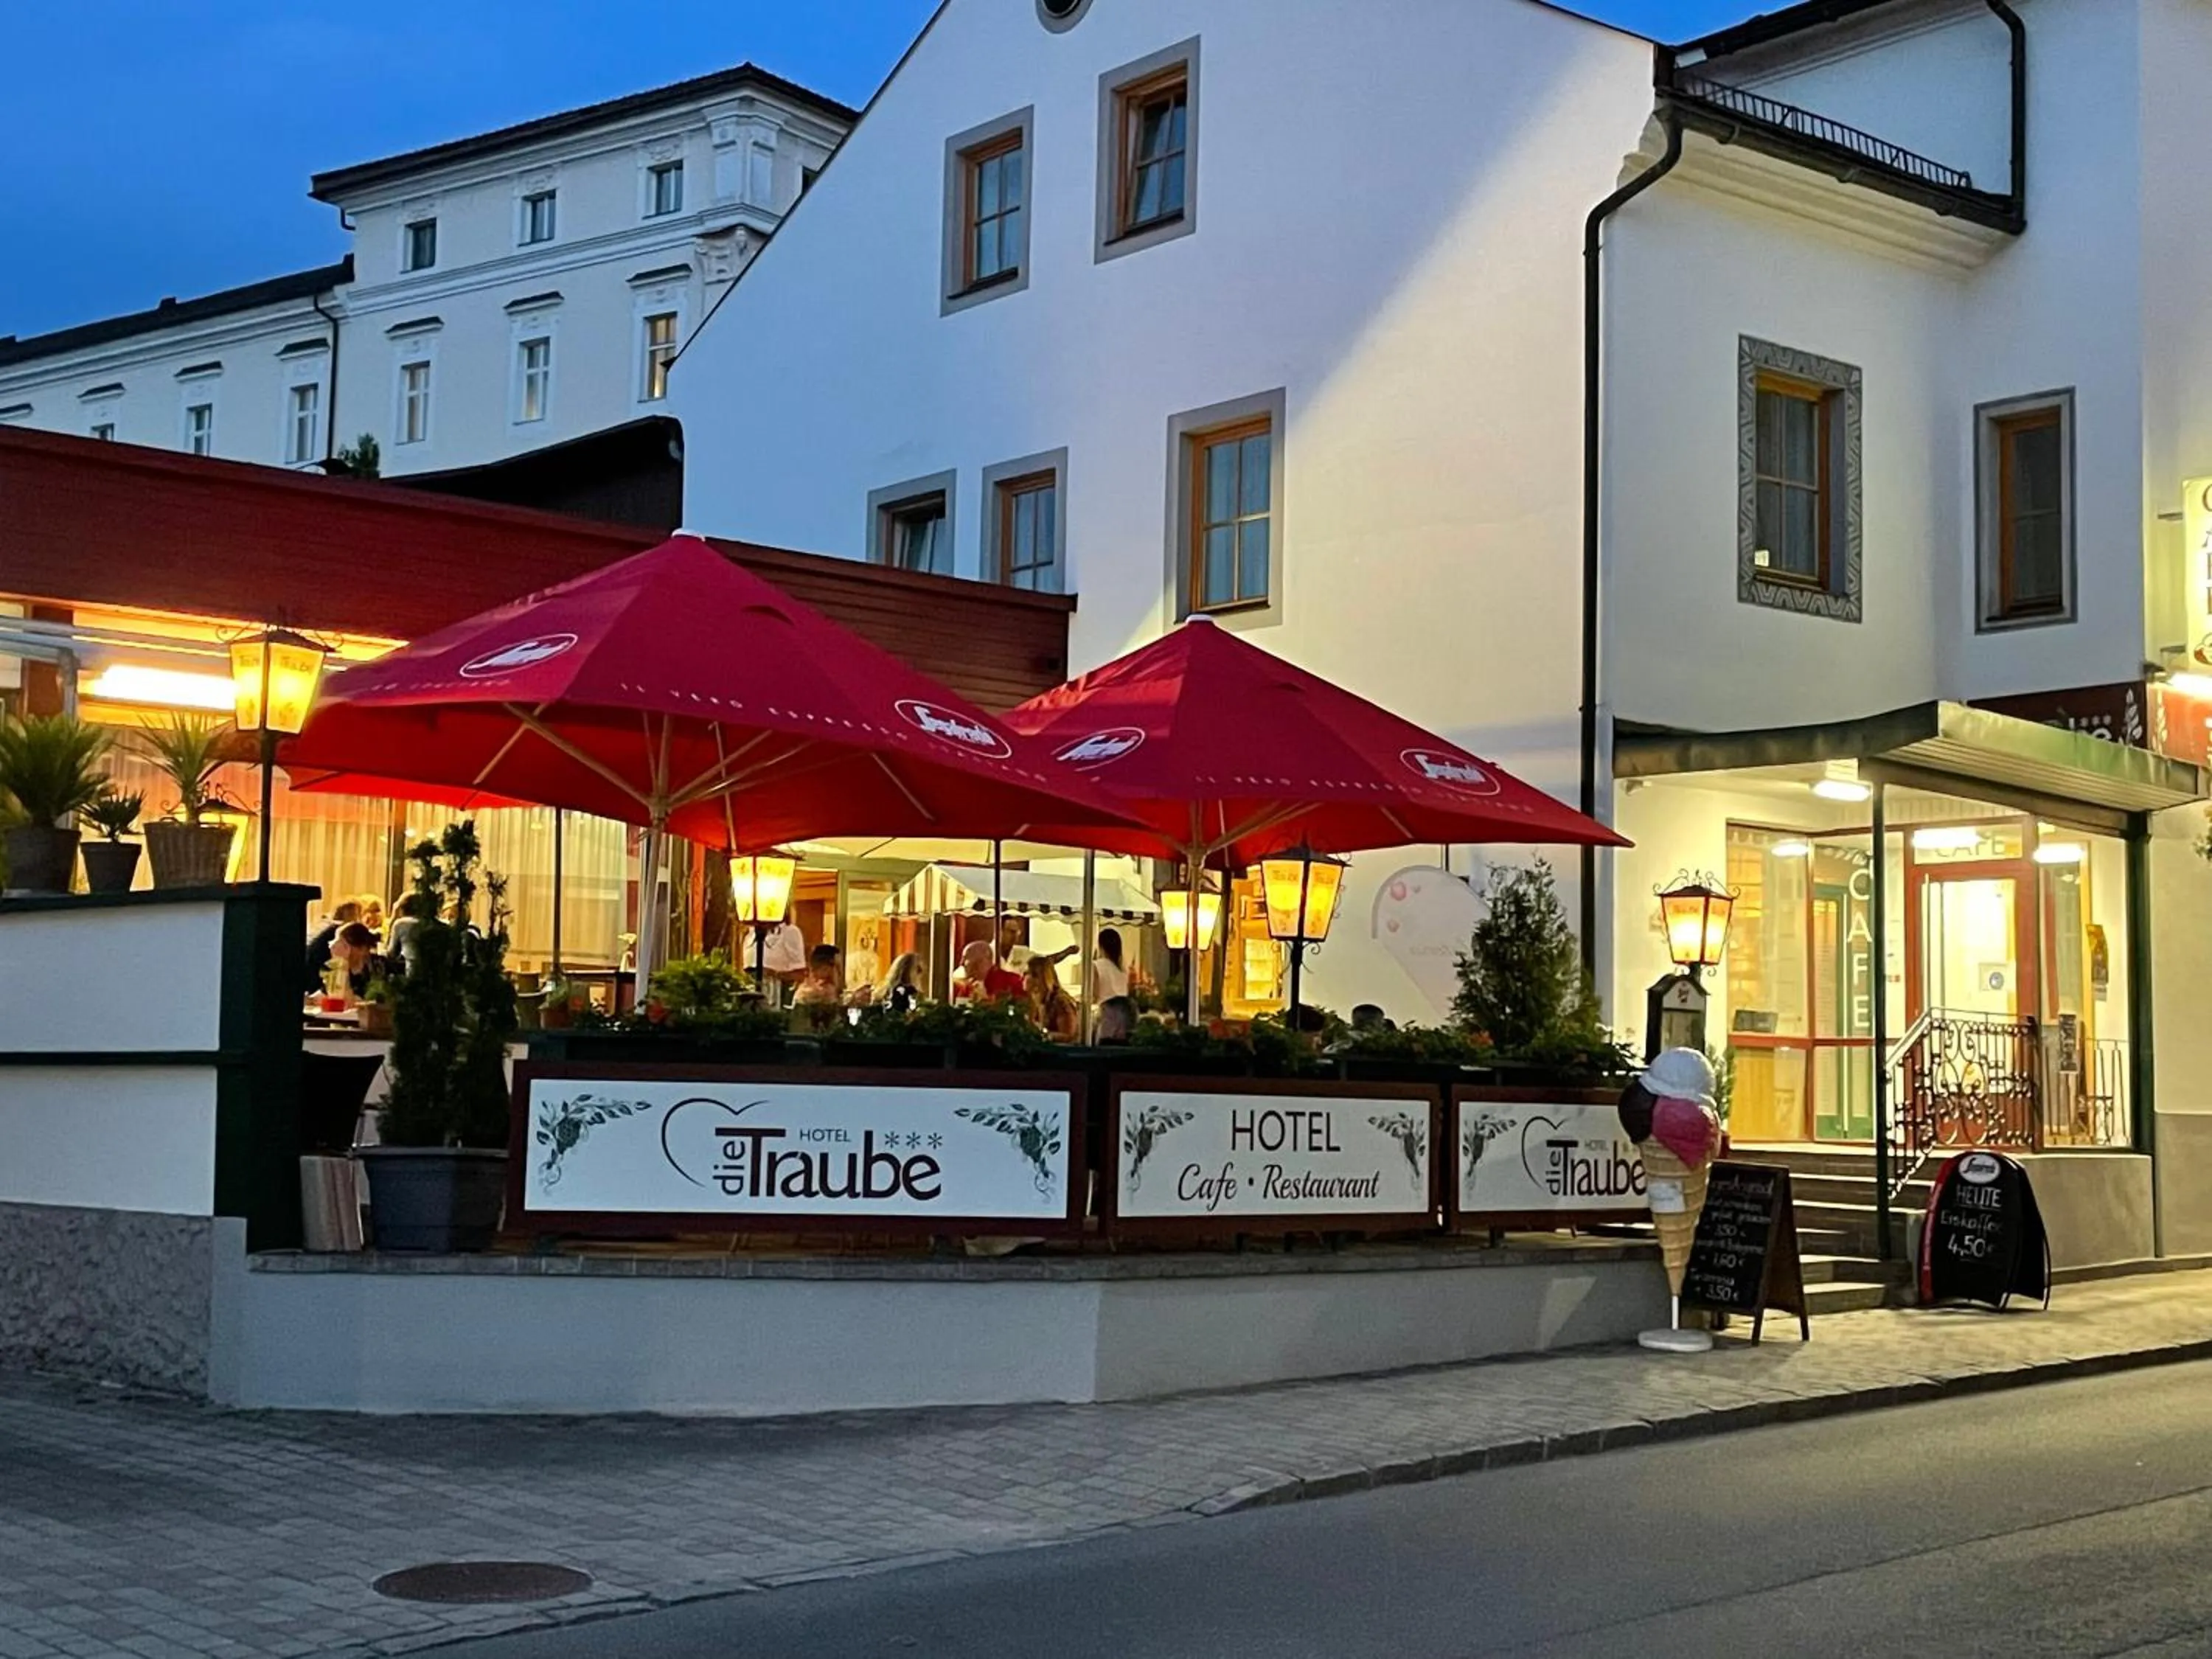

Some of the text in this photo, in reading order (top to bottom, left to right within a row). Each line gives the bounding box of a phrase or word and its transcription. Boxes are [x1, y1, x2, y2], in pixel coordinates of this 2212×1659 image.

[800, 1129, 851, 1142] HOTEL
[1232, 1110, 1341, 1152] HOTEL
[713, 1128, 942, 1200] die Traube
[1178, 1162, 1380, 1211] Cafe Restaurant
[1545, 1140, 1646, 1196] die Traube
